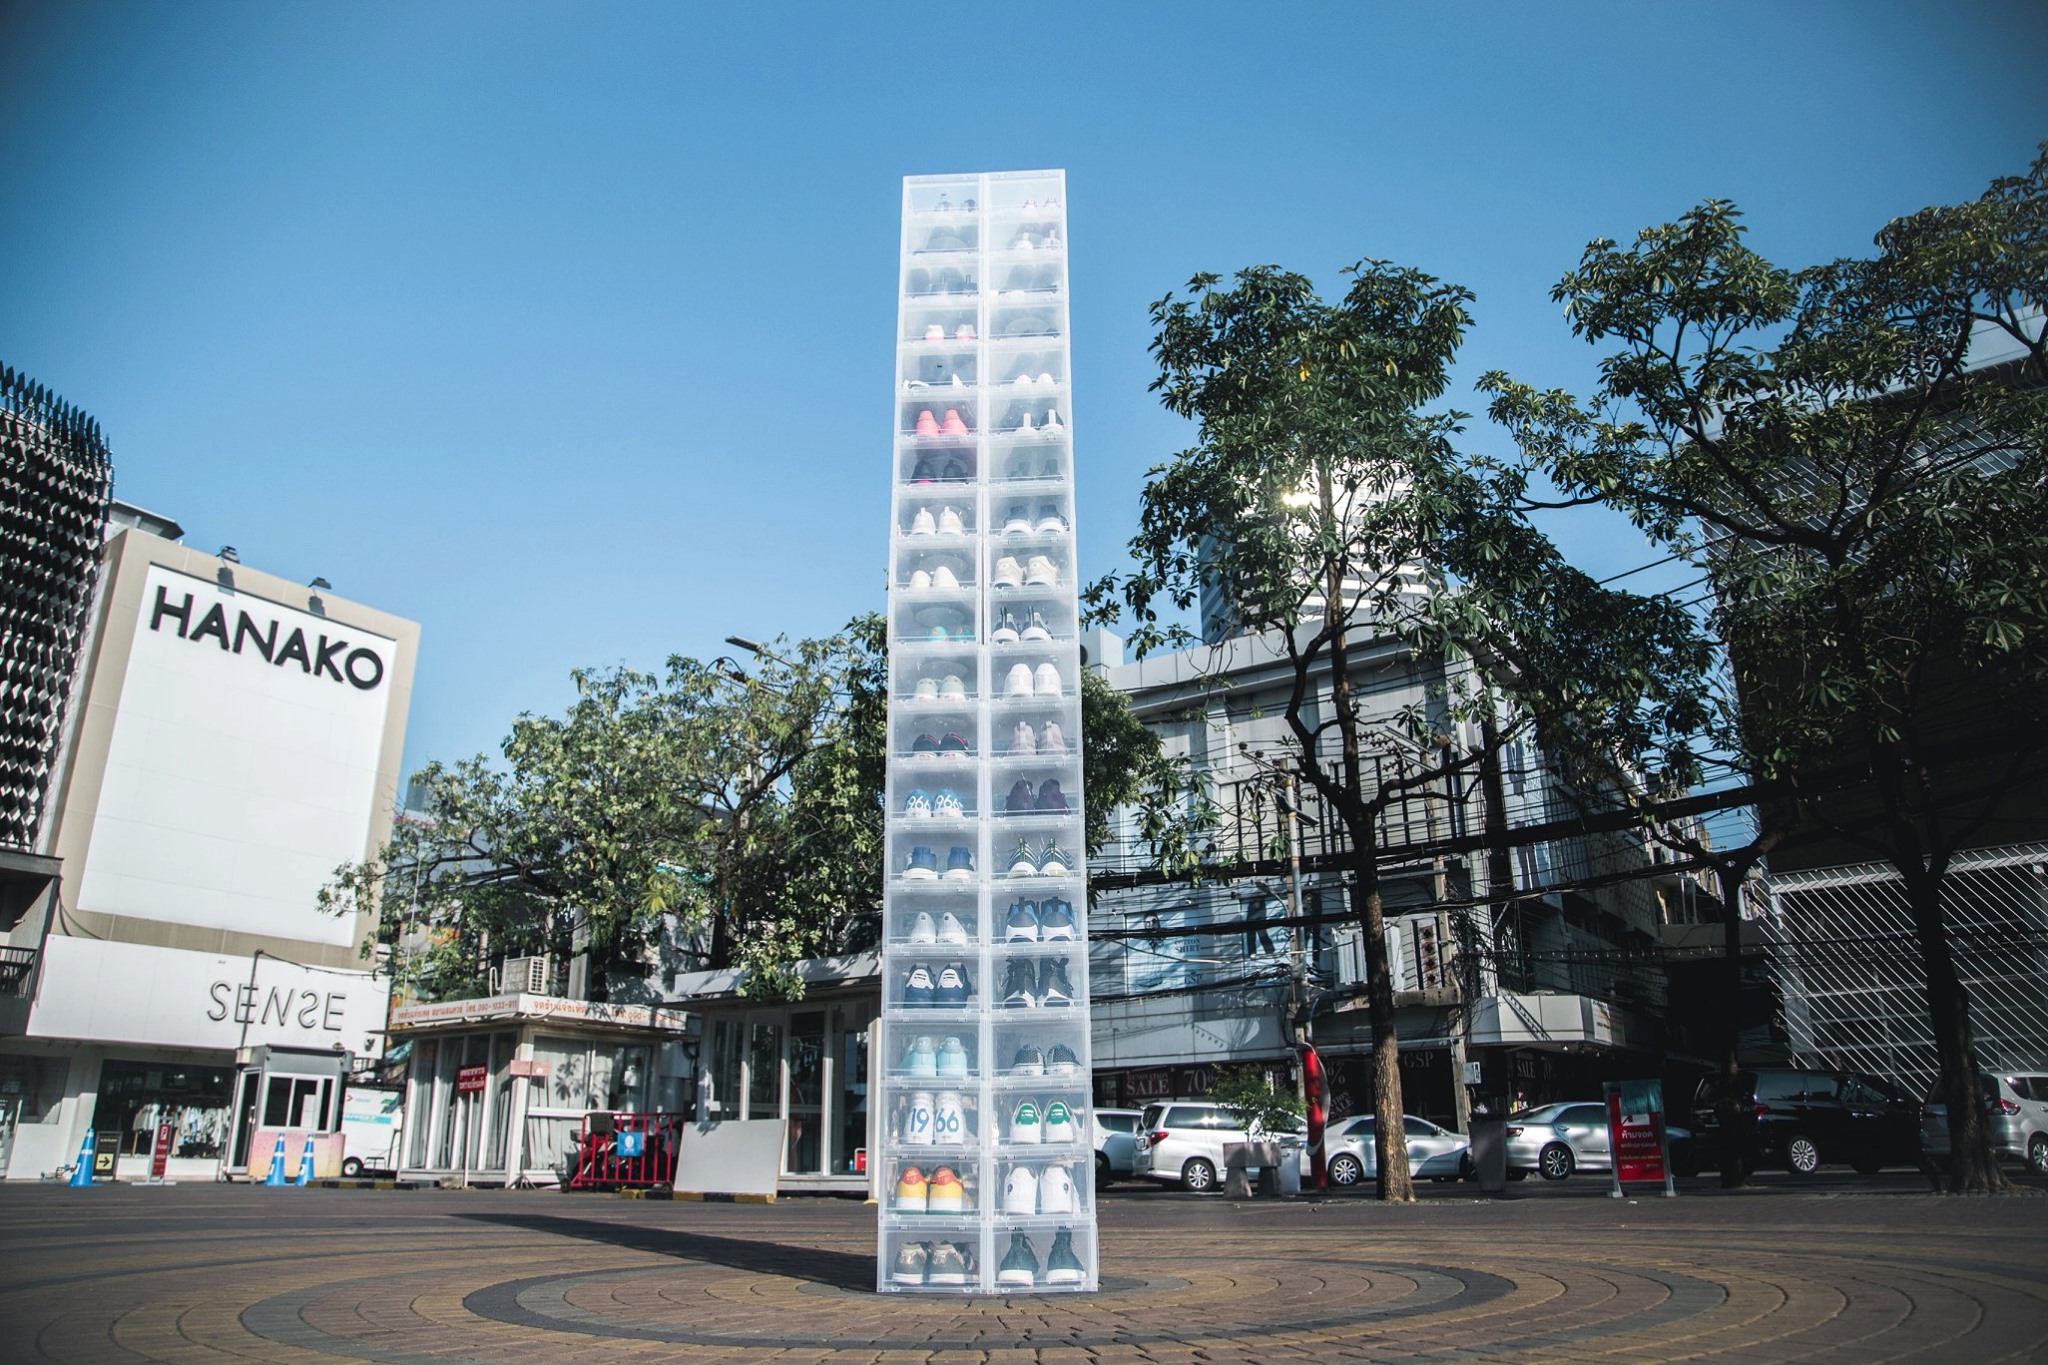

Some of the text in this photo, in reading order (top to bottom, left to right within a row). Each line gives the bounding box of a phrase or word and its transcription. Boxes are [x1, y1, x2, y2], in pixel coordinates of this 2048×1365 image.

[150, 585, 384, 690] HANAKO
[1404, 1051, 1434, 1068] GSP
[1127, 1071, 1169, 1082] RENOVATION
[1516, 1059, 1536, 1079] SALE
[1126, 1079, 1170, 1096] SALE
